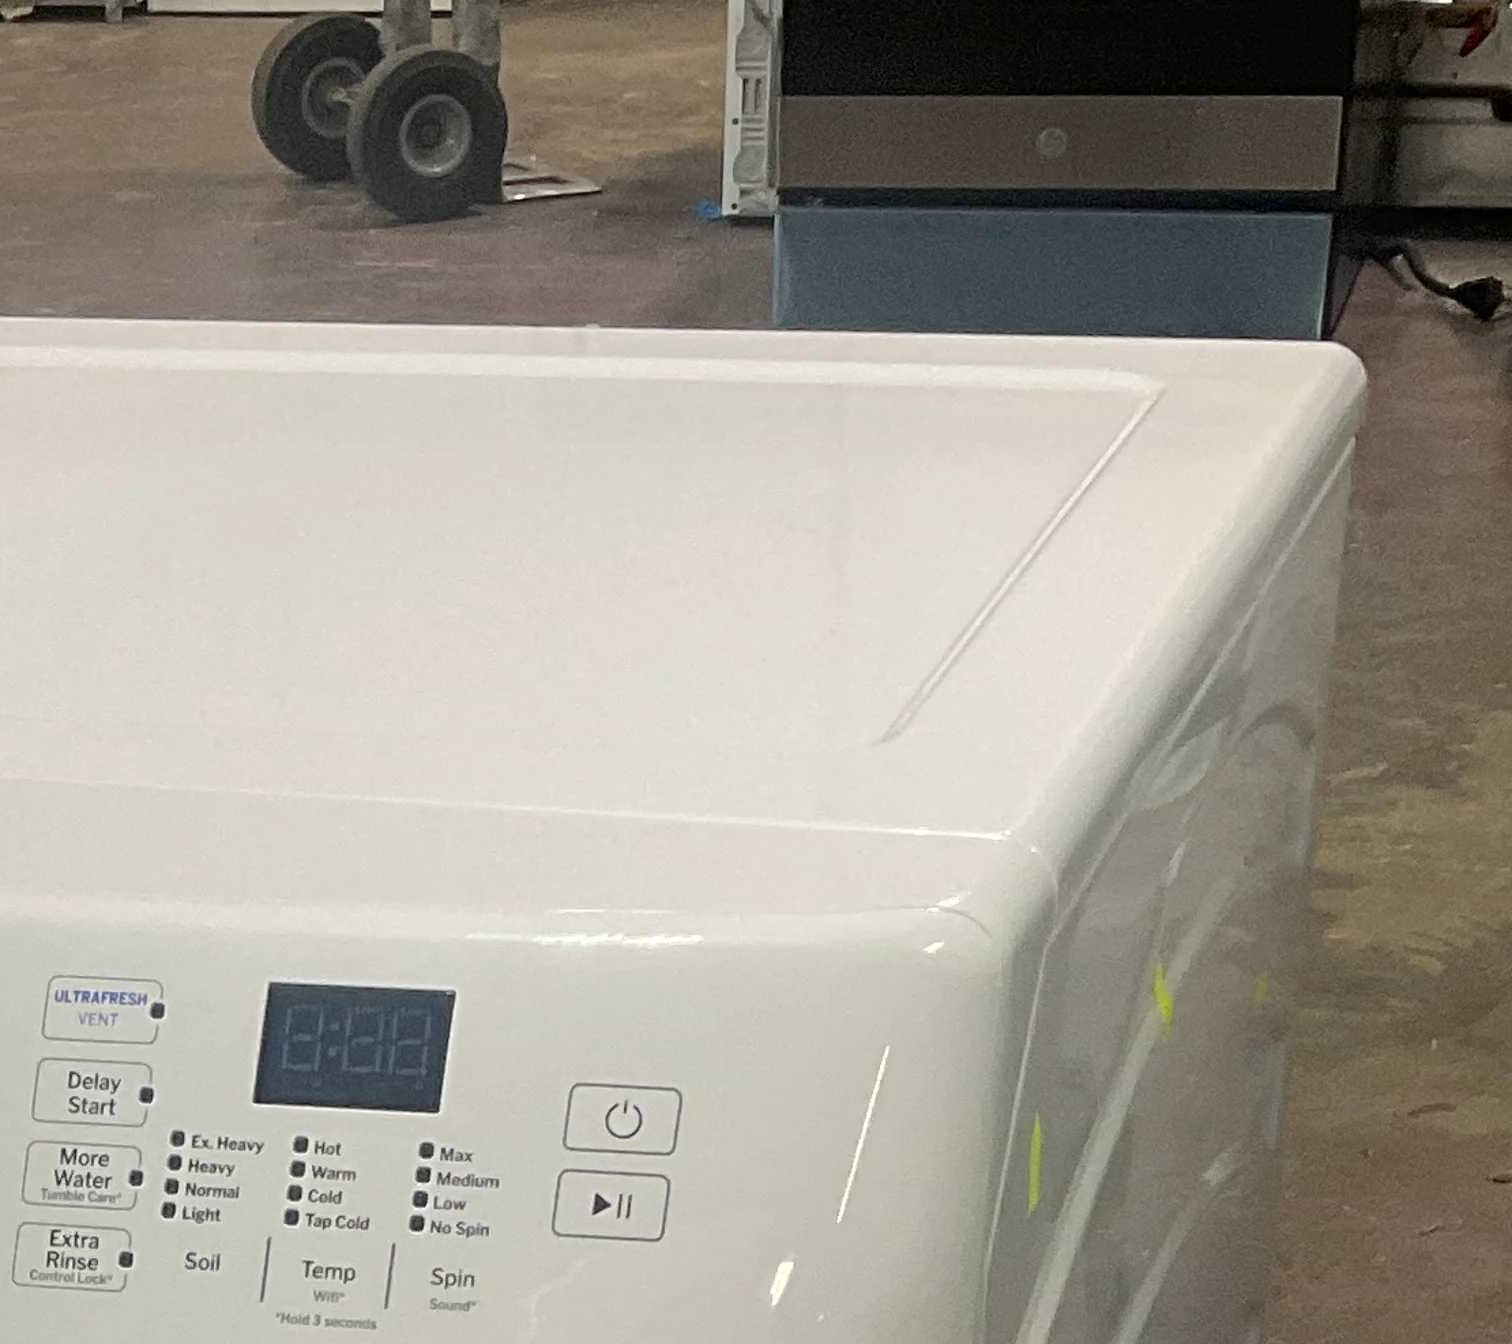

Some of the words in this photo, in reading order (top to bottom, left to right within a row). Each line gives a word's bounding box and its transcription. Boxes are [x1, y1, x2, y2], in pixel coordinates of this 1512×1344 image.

[54, 989, 148, 1006] ULTRAFRESH
[79, 1012, 119, 1027] VENT
[67, 1070, 122, 1094] Delay
[67, 1095, 116, 1116] Start
[191, 1134, 212, 1150] Ex.
[217, 1136, 265, 1155] Heavy
[313, 1140, 341, 1156] Hot
[59, 1147, 110, 1167] More
[439, 1147, 474, 1162] Max
[188, 1158, 235, 1177] Heavy
[311, 1164, 357, 1182] Warm
[54, 1169, 113, 1189] Water
[435, 1171, 500, 1189] Medium
[41, 1187, 85, 1201] Tumble
[184, 1182, 240, 1199] Normal
[307, 1188, 344, 1205] Cold
[433, 1195, 467, 1211] Low
[182, 1206, 221, 1224] Light
[305, 1212, 332, 1230] Tap
[335, 1215, 371, 1231] Cold
[429, 1219, 452, 1234] No
[454, 1221, 490, 1238] Spin
[49, 1229, 100, 1249] Extra
[45, 1250, 99, 1271] Rinse
[184, 1252, 221, 1272] Soil
[29, 1268, 75, 1283] Control
[302, 1260, 357, 1284] Temp
[429, 1266, 476, 1290] Spin
[312, 1314, 321, 1327] 3
[324, 1317, 377, 1331] seconds
